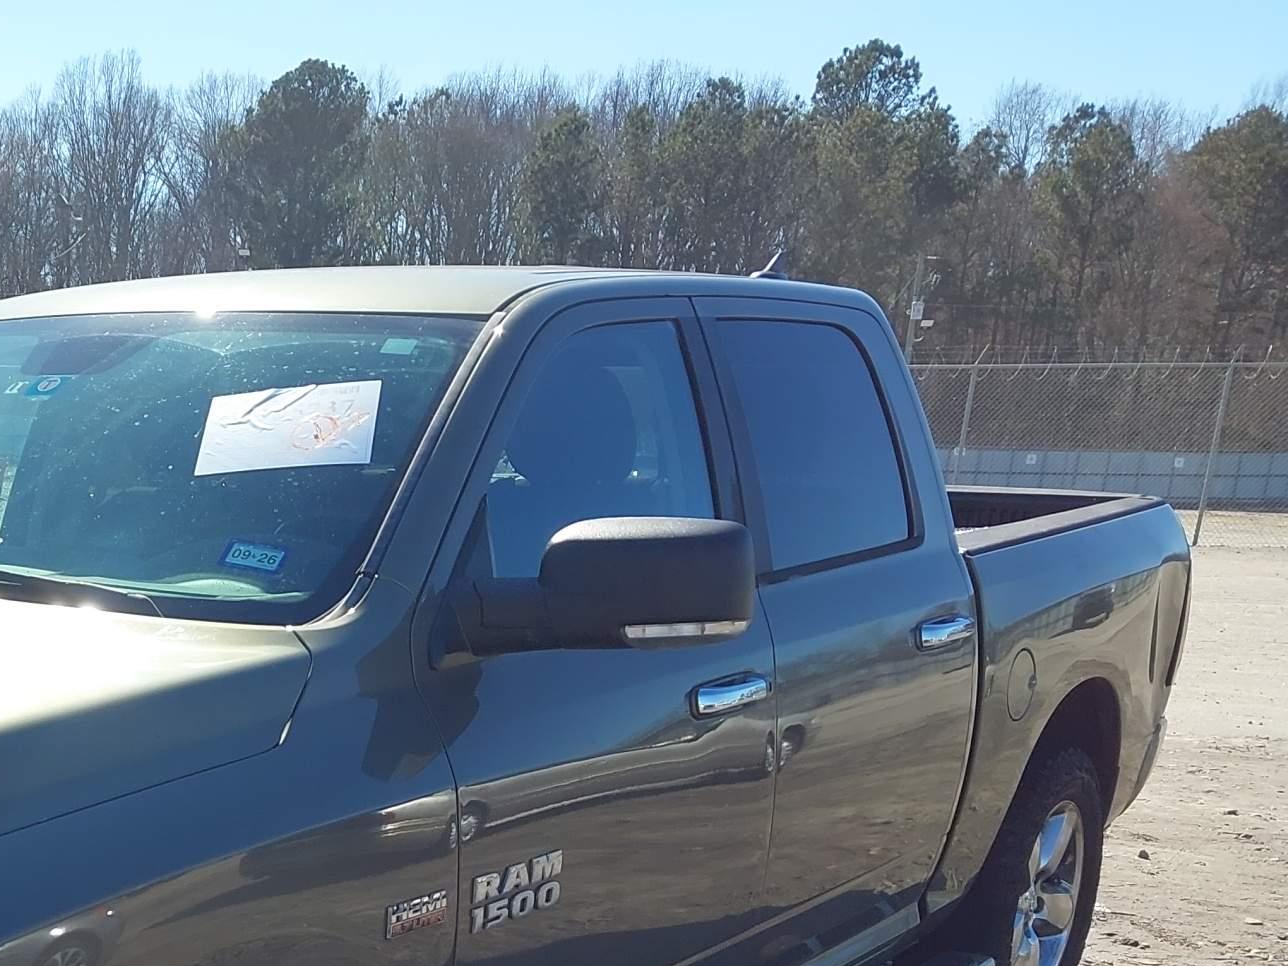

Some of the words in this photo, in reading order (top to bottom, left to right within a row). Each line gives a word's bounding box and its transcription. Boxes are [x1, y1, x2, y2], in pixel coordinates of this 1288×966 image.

[474, 850, 563, 903] RAM
[391, 890, 447, 923] HEMI
[472, 881, 561, 934] 1500
